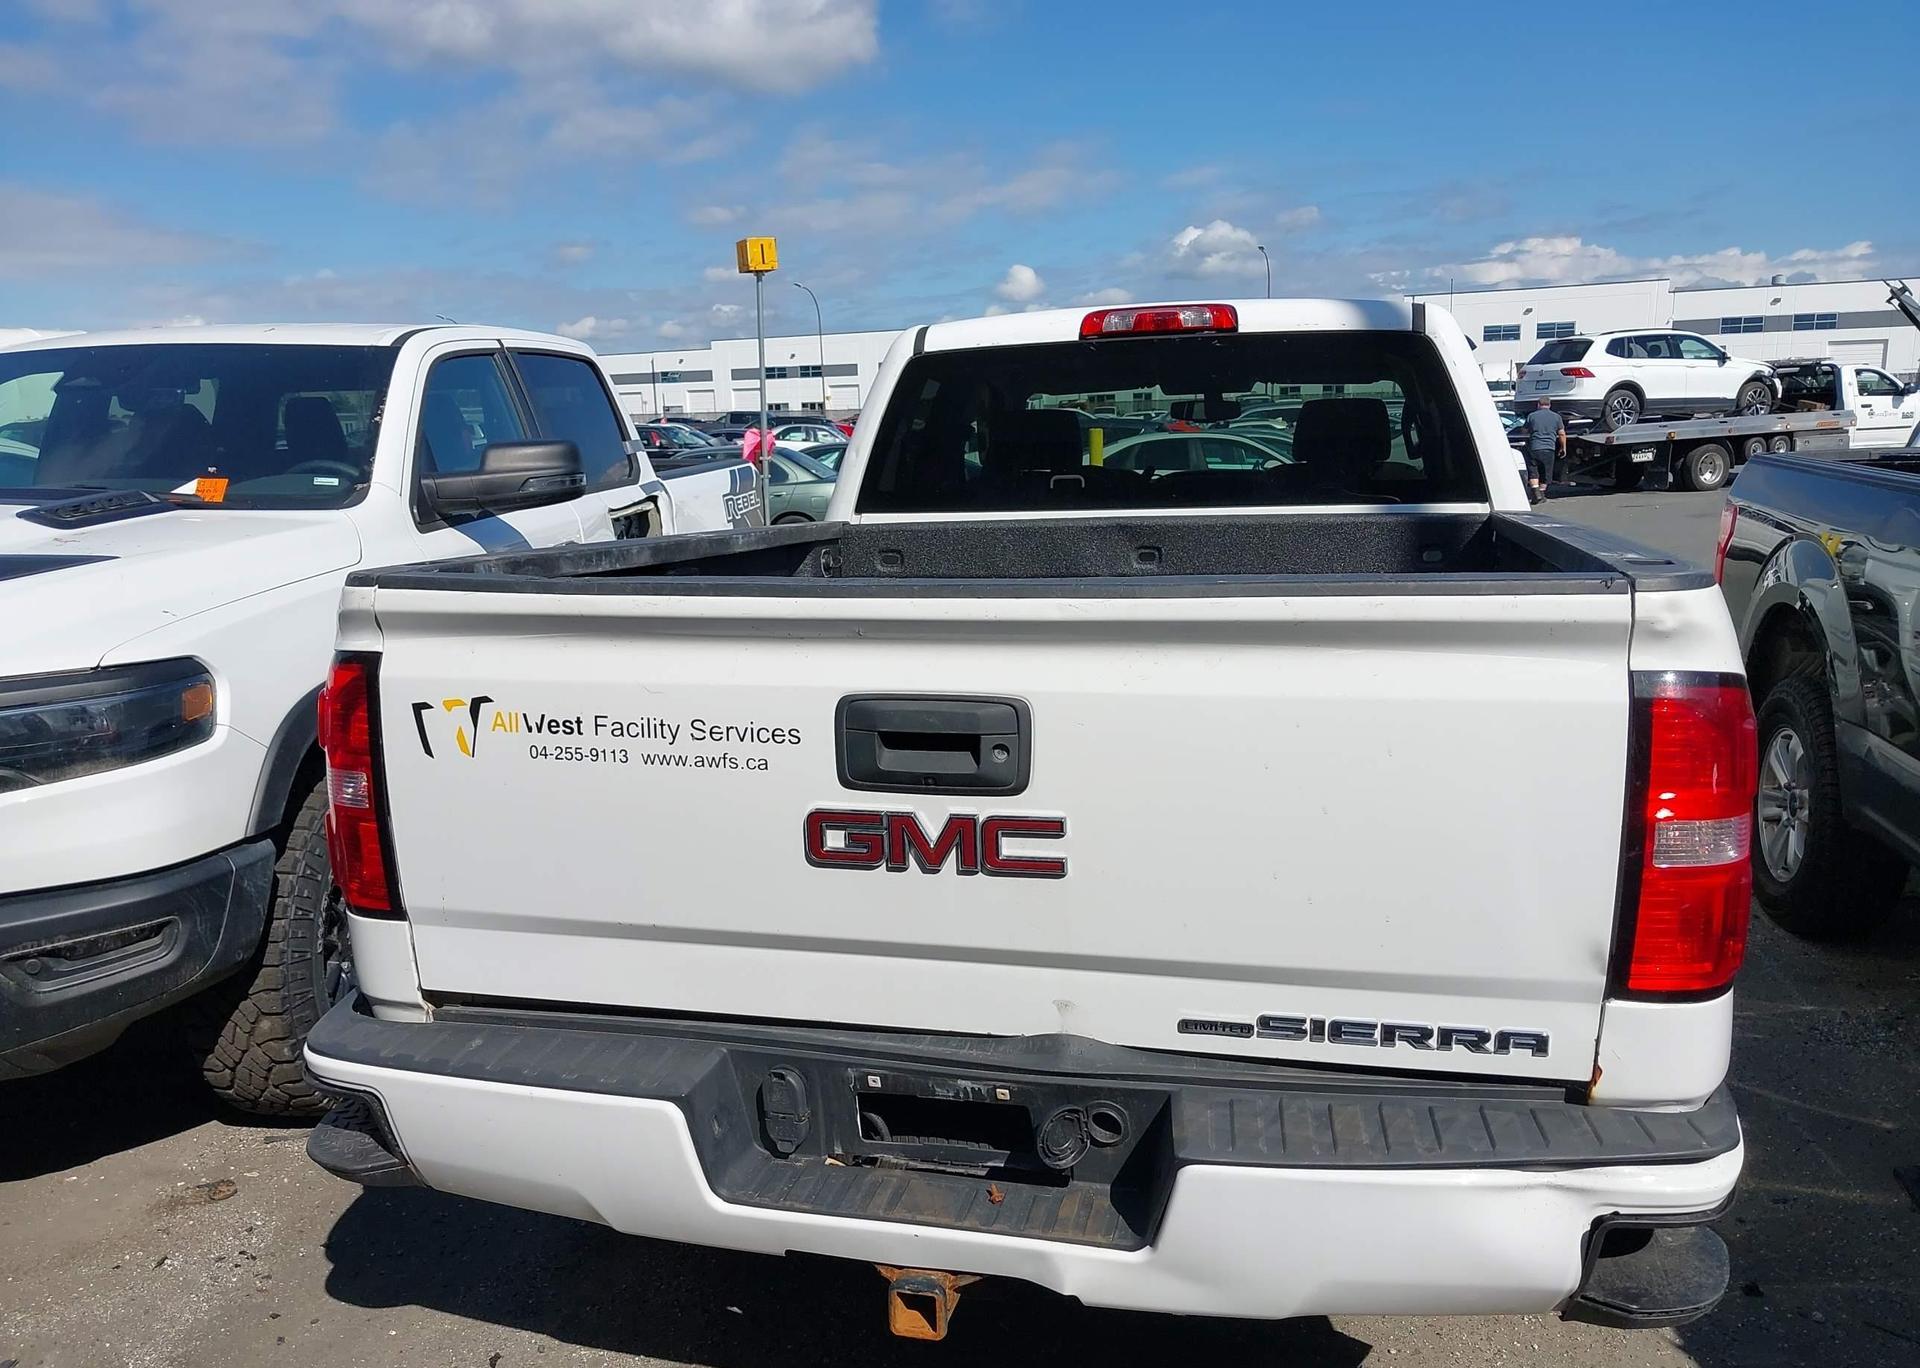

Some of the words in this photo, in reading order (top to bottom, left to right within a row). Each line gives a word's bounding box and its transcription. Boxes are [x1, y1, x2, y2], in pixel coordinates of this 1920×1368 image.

[725, 491, 761, 519] REBEL
[594, 714, 680, 745] Facility
[690, 719, 802, 745] Services
[529, 745, 629, 764] 04-255-9113
[641, 751, 769, 771] www.awfs.ca
[804, 808, 1068, 879] GMC
[1180, 1019, 1253, 1036] LIMITED
[1257, 1014, 1550, 1057] SIERRA
